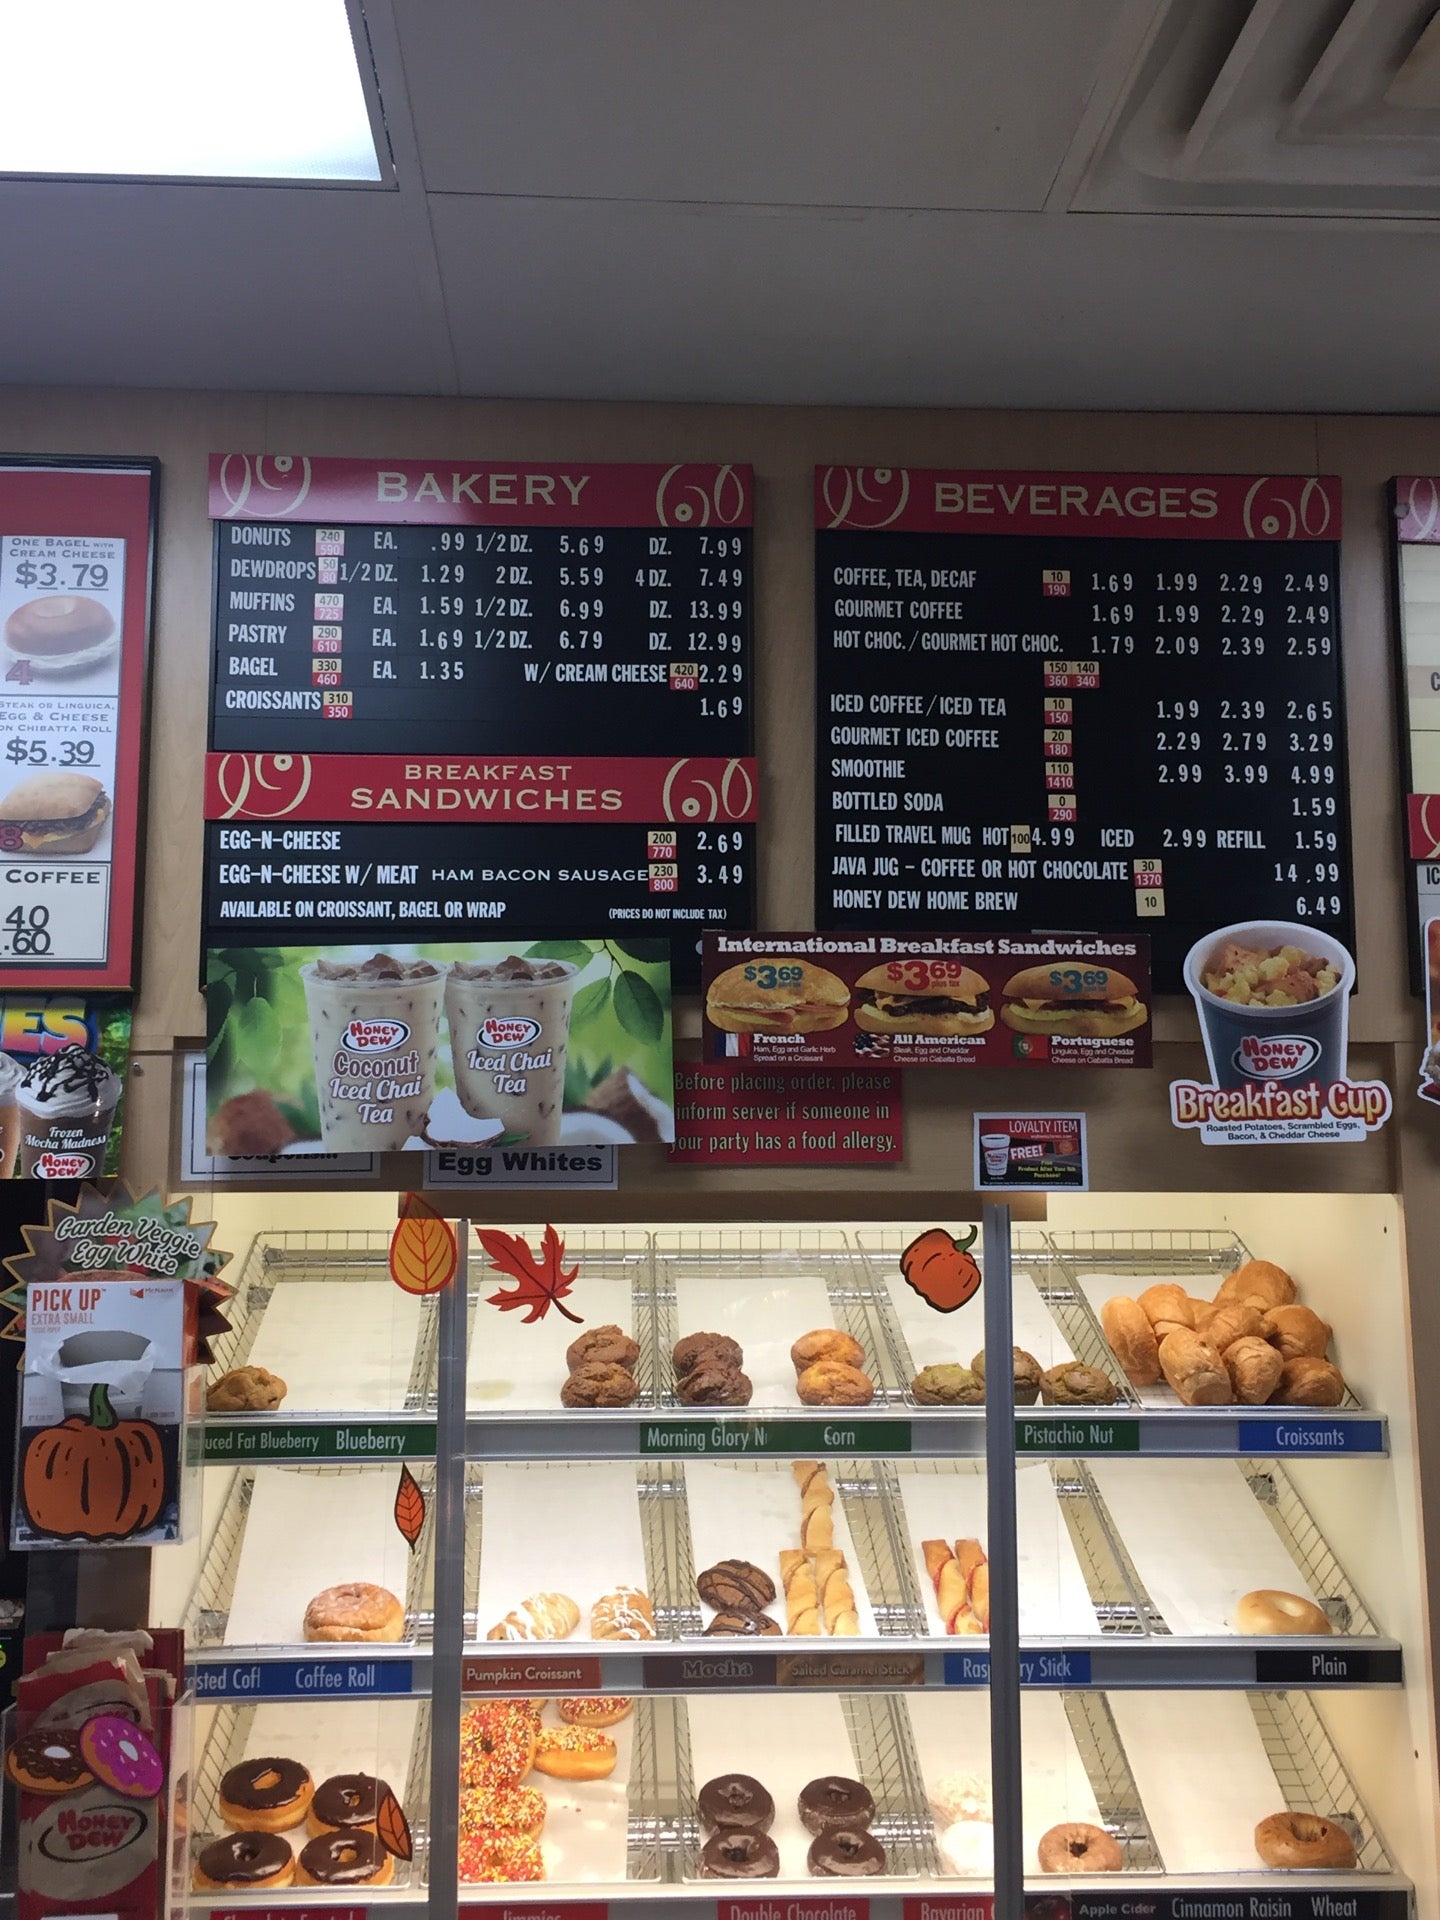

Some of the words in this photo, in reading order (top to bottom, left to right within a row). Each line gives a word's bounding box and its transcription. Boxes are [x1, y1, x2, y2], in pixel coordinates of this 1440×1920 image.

[376, 471, 591, 506] BAKERY
[935, 482, 1219, 519] BEVERAGES
[231, 526, 291, 546] DONUTS
[374, 531, 398, 550] EA.
[432, 532, 464, 551] .99
[476, 532, 506, 554] 1/2
[510, 534, 532, 552] DZ.
[560, 536, 604, 556] 5.69
[649, 537, 672, 555] DZ.
[700, 537, 741, 557] 7.99
[9, 549, 56, 558] CREAM
[62, 550, 115, 559] CHEESE
[15, 560, 109, 589] $3.79
[834, 567, 891, 589] COFFEE,
[896, 569, 926, 590] TEA,
[931, 570, 976, 588] DECAF
[1092, 573, 1133, 592] 1.69
[1157, 573, 1198, 591] 1.99
[1220, 574, 1262, 593] 2.29
[1285, 574, 1329, 592] 2.49
[317, 660, 337, 671] 330
[317, 674, 337, 685] 460
[226, 690, 321, 710] CROISSANTS
[700, 697, 742, 717] 1.69
[328, 693, 348, 704] 310
[328, 706, 348, 717] 350
[5, 736, 95, 765] $5.39
[404, 764, 573, 781] BREAKFAST
[831, 759, 905, 778] SMOOTHIE
[1159, 764, 1202, 783] 2.99
[1225, 765, 1268, 783] 3.99
[1291, 766, 1334, 784] 4.99
[351, 788, 623, 811] SANDWICHES
[833, 792, 898, 810] BOTTLED
[904, 793, 943, 812] SODA
[1293, 798, 1336, 816] 1.59
[220, 830, 340, 850] EGG-N-CHEESE
[697, 832, 742, 853] 2.69
[653, 833, 672, 844] 200
[653, 847, 672, 858] 770
[6, 869, 100, 884] COFFEE
[220, 865, 340, 884] EGG-N-CHEESE
[346, 863, 373, 886] W/
[377, 865, 418, 884] MEAT
[432, 869, 474, 880] HAM
[482, 869, 551, 881] BACON
[558, 869, 649, 881] SAUSAGE
[697, 865, 742, 884] 3.49
[654, 865, 672, 877] 230
[654, 880, 673, 890] 800
[220, 901, 291, 918] AVAILABLE
[295, 901, 313, 918] ON
[317, 901, 396, 920] CROISSANT,
[399, 902, 441, 918] BAGEL
[445, 902, 463, 918] OR
[466, 902, 506, 918] WRAP
[833, 890, 881, 908] HONEY
[888, 890, 920, 909] DEW
[927, 891, 968, 910] HOME
[975, 892, 1017, 911] BREW
[1297, 897, 1340, 915] 6.49
[609, 908, 640, 919] (PRICES
[642, 909, 653, 919] DO
[655, 909, 671, 919] NOT
[673, 909, 704, 919] INCLUDE
[708, 909, 727, 920] TAX)
[718, 937, 876, 954] International
[880, 938, 994, 955] Breakfast
[998, 939, 1137, 956] Sandwiches
[350, 1021, 400, 1037] HONEY
[486, 1019, 532, 1033] HONEY
[356, 1035, 393, 1047] DEW
[492, 1032, 525, 1044] DEW
[753, 1033, 805, 1044] French
[893, 1034, 913, 1045] All
[915, 1034, 986, 1045] American
[1051, 1035, 1134, 1048] Portuguese
[1242, 1038, 1307, 1057] HONEY
[772, 1046, 785, 1054] Egg
[333, 1051, 419, 1078] Coconut
[467, 1051, 506, 1071] Iced
[510, 1049, 552, 1071] Chai
[1252, 1056, 1299, 1071] DEW
[330, 1077, 370, 1100] Iced
[376, 1076, 422, 1100] Chai
[493, 1074, 526, 1093] Tea
[676, 1072, 725, 1090] Before
[731, 1073, 785, 1093] placing
[842, 1072, 892, 1091] please
[677, 1101, 726, 1120] inform
[732, 1104, 779, 1120] server
[786, 1101, 796, 1120] if
[802, 1103, 870, 1120] someone
[876, 1101, 890, 1120] in
[1176, 1083, 1321, 1121] Breakfast
[1328, 1084, 1385, 1122] Cup
[358, 1105, 393, 1124] Tea
[49, 1126, 83, 1138] Frozen
[1009, 1120, 1051, 1133] LOYALTY
[1054, 1120, 1078, 1133] ITEM
[1206, 1124, 1243, 1132] Roasted
[1245, 1123, 1285, 1132] Potatoes,
[1287, 1121, 1334, 1130] Scrambled
[1336, 1121, 1361, 1131] Eggs,
[1228, 1133, 1258, 1141] Bacon,
[1260, 1132, 1267, 1140] &
[1268, 1131, 1305, 1139] Cheddar
[1307, 1130, 1340, 1139] Cheese
[25, 1135, 59, 1149] Mocha
[61, 1135, 106, 1149] Madness
[709, 1132, 750, 1152] party
[755, 1131, 782, 1150] has
[788, 1136, 796, 1150] a
[802, 1131, 836, 1150] food
[842, 1131, 897, 1152] allergy.
[41, 1153, 84, 1168] HONEY
[1010, 1145, 1044, 1160] FREE!
[46, 1167, 78, 1177] DEW
[438, 1152, 493, 1176] Egg
[503, 1152, 602, 1171] Whites
[56, 1212, 131, 1240] Garden
[138, 1218, 201, 1258] Veggie
[72, 1241, 114, 1268] Egg
[116, 1243, 178, 1274] White
[32, 1289, 72, 1312] PICK
[31, 1313, 60, 1326] EXTRA
[64, 1312, 94, 1325] SMALL
[336, 1428, 406, 1453] Blueberry
[1024, 1424, 1084, 1444] Pistachio
[1090, 1424, 1114, 1444] Nut
[1276, 1426, 1345, 1446] Croissants
[683, 1660, 753, 1679] Mocha
[1312, 1654, 1348, 1676] Plain
[295, 1665, 342, 1689] Coffee
[348, 1664, 375, 1688] Roll
[466, 1667, 522, 1685] Pumpkin
[524, 1666, 582, 1681] Croissant
[58, 1809, 135, 1834] HONEY
[66, 1831, 125, 1851] DEW
[1079, 1903, 1118, 1916] Apple
[1121, 1903, 1157, 1915] Cider
[1171, 1898, 1244, 1918] Cinnamon
[1250, 1898, 1291, 1918] Raisin
[1311, 1897, 1357, 1917] Wheat
